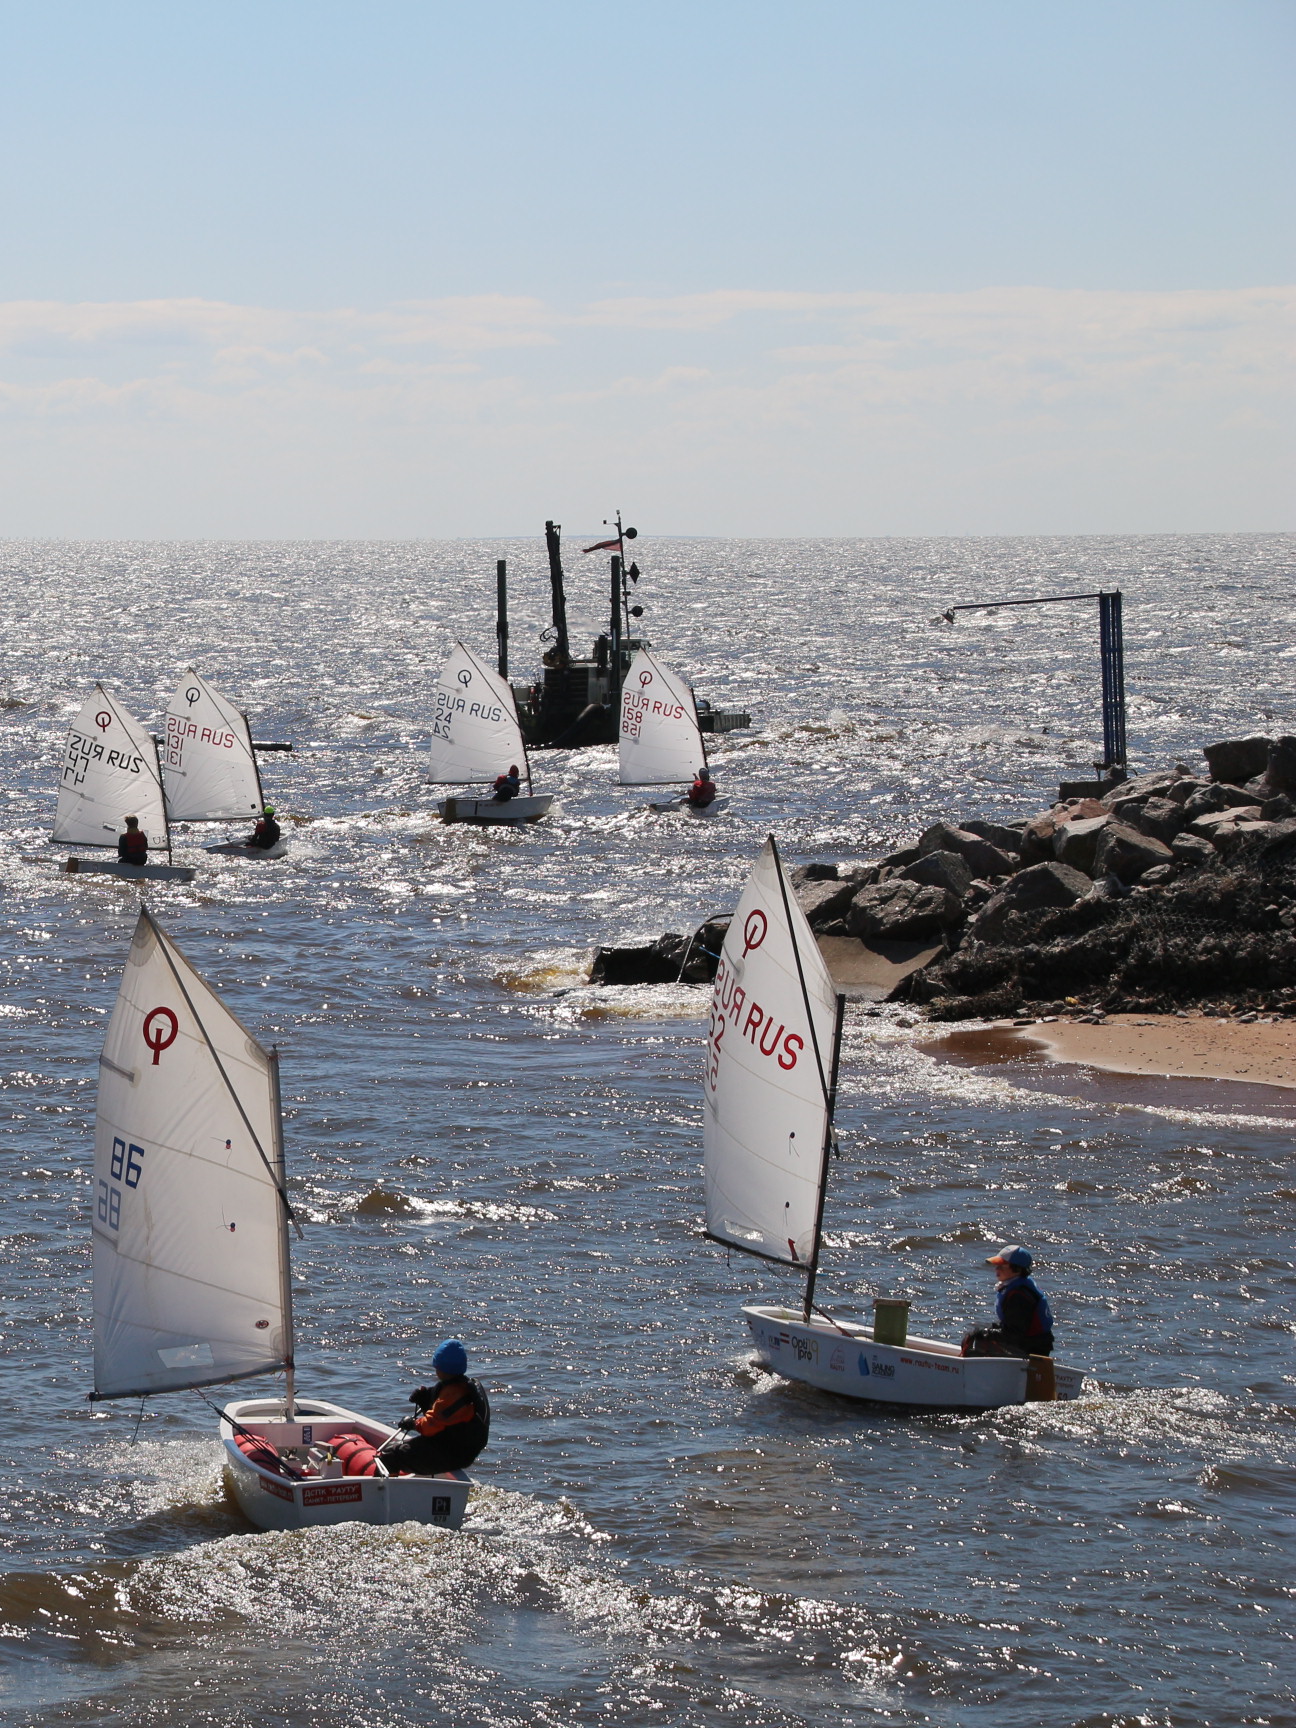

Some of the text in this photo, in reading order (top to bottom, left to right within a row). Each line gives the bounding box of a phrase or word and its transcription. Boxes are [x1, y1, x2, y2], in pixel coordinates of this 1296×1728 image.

[435, 708, 452, 724] 24
[469, 702, 502, 722] RUS
[622, 706, 642, 723] 128
[652, 700, 684, 720] RUS
[166, 733, 184, 751] 131
[200, 727, 235, 749] RUS
[68, 750, 90, 773] 47
[106, 749, 143, 774] RUS
[743, 1001, 804, 1071] RUS
[110, 1136, 145, 1190] 86
[304, 1488, 327, 1498] ДСПК
